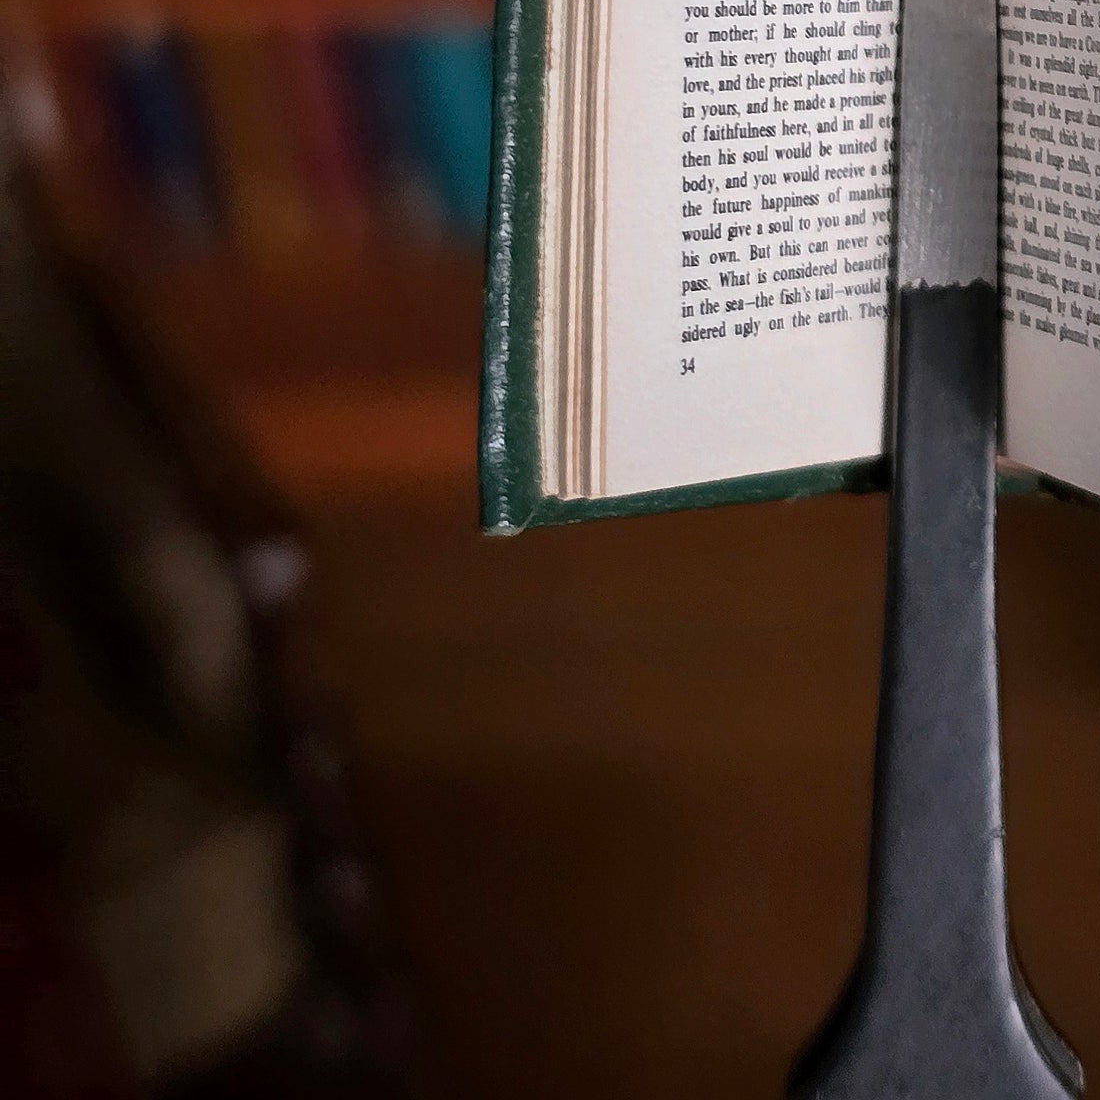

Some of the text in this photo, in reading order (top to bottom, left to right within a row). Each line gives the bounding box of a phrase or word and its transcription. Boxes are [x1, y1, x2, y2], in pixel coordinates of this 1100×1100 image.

[685, 4, 709, 22] you
[714, 1, 757, 18] should
[762, 0, 777, 16] be
[782, 2, 814, 15] more
[819, 0, 832, 14] to
[685, 30, 698, 43] or
[708, 24, 758, 43] mother;
[766, 23, 776, 40] if
[783, 22, 797, 39] he
[805, 21, 846, 39] should
[853, 20, 881, 38] cling
[684, 43, 890, 68] with his every thought and with
[683, 66, 892, 95] love, and the priest placed his righ
[682, 91, 887, 120] in yours, and he made a promise
[682, 125, 697, 143] of
[703, 122, 776, 141] faithfulness
[782, 119, 811, 137] here,
[815, 116, 838, 133] and
[843, 116, 854, 131] in
[859, 113, 873, 130] all
[682, 151, 711, 168] then
[718, 148, 736, 165] his
[743, 145, 768, 164] soul
[774, 141, 812, 160] would
[819, 141, 832, 157] be
[839, 136, 877, 155] united
[682, 174, 719, 194] body,
[724, 171, 748, 189] and
[753, 173, 777, 190] you
[783, 164, 820, 184] would
[825, 163, 865, 180] receive
[870, 165, 877, 176] a
[682, 200, 702, 218] the
[713, 197, 752, 215] future
[760, 191, 820, 213] happiness
[828, 186, 842, 203] of
[682, 222, 722, 242] would
[727, 221, 751, 242] give
[757, 223, 763, 235] a
[767, 215, 793, 234] soul
[799, 217, 810, 230] to
[817, 216, 840, 232] you
[845, 208, 866, 226] and
[682, 250, 700, 267] his
[708, 251, 741, 264] own.
[748, 244, 771, 261] But
[779, 239, 801, 257] this
[808, 241, 828, 254] can
[837, 236, 868, 250] never
[682, 252, 890, 296] pass. What is considered beautif
[681, 302, 694, 318] in
[700, 298, 720, 315] the
[681, 321, 726, 343] sidered
[734, 317, 761, 338] ugly
[769, 318, 784, 330] on
[792, 311, 811, 328] the
[818, 305, 852, 324] earth.
[681, 357, 695, 375] 34
